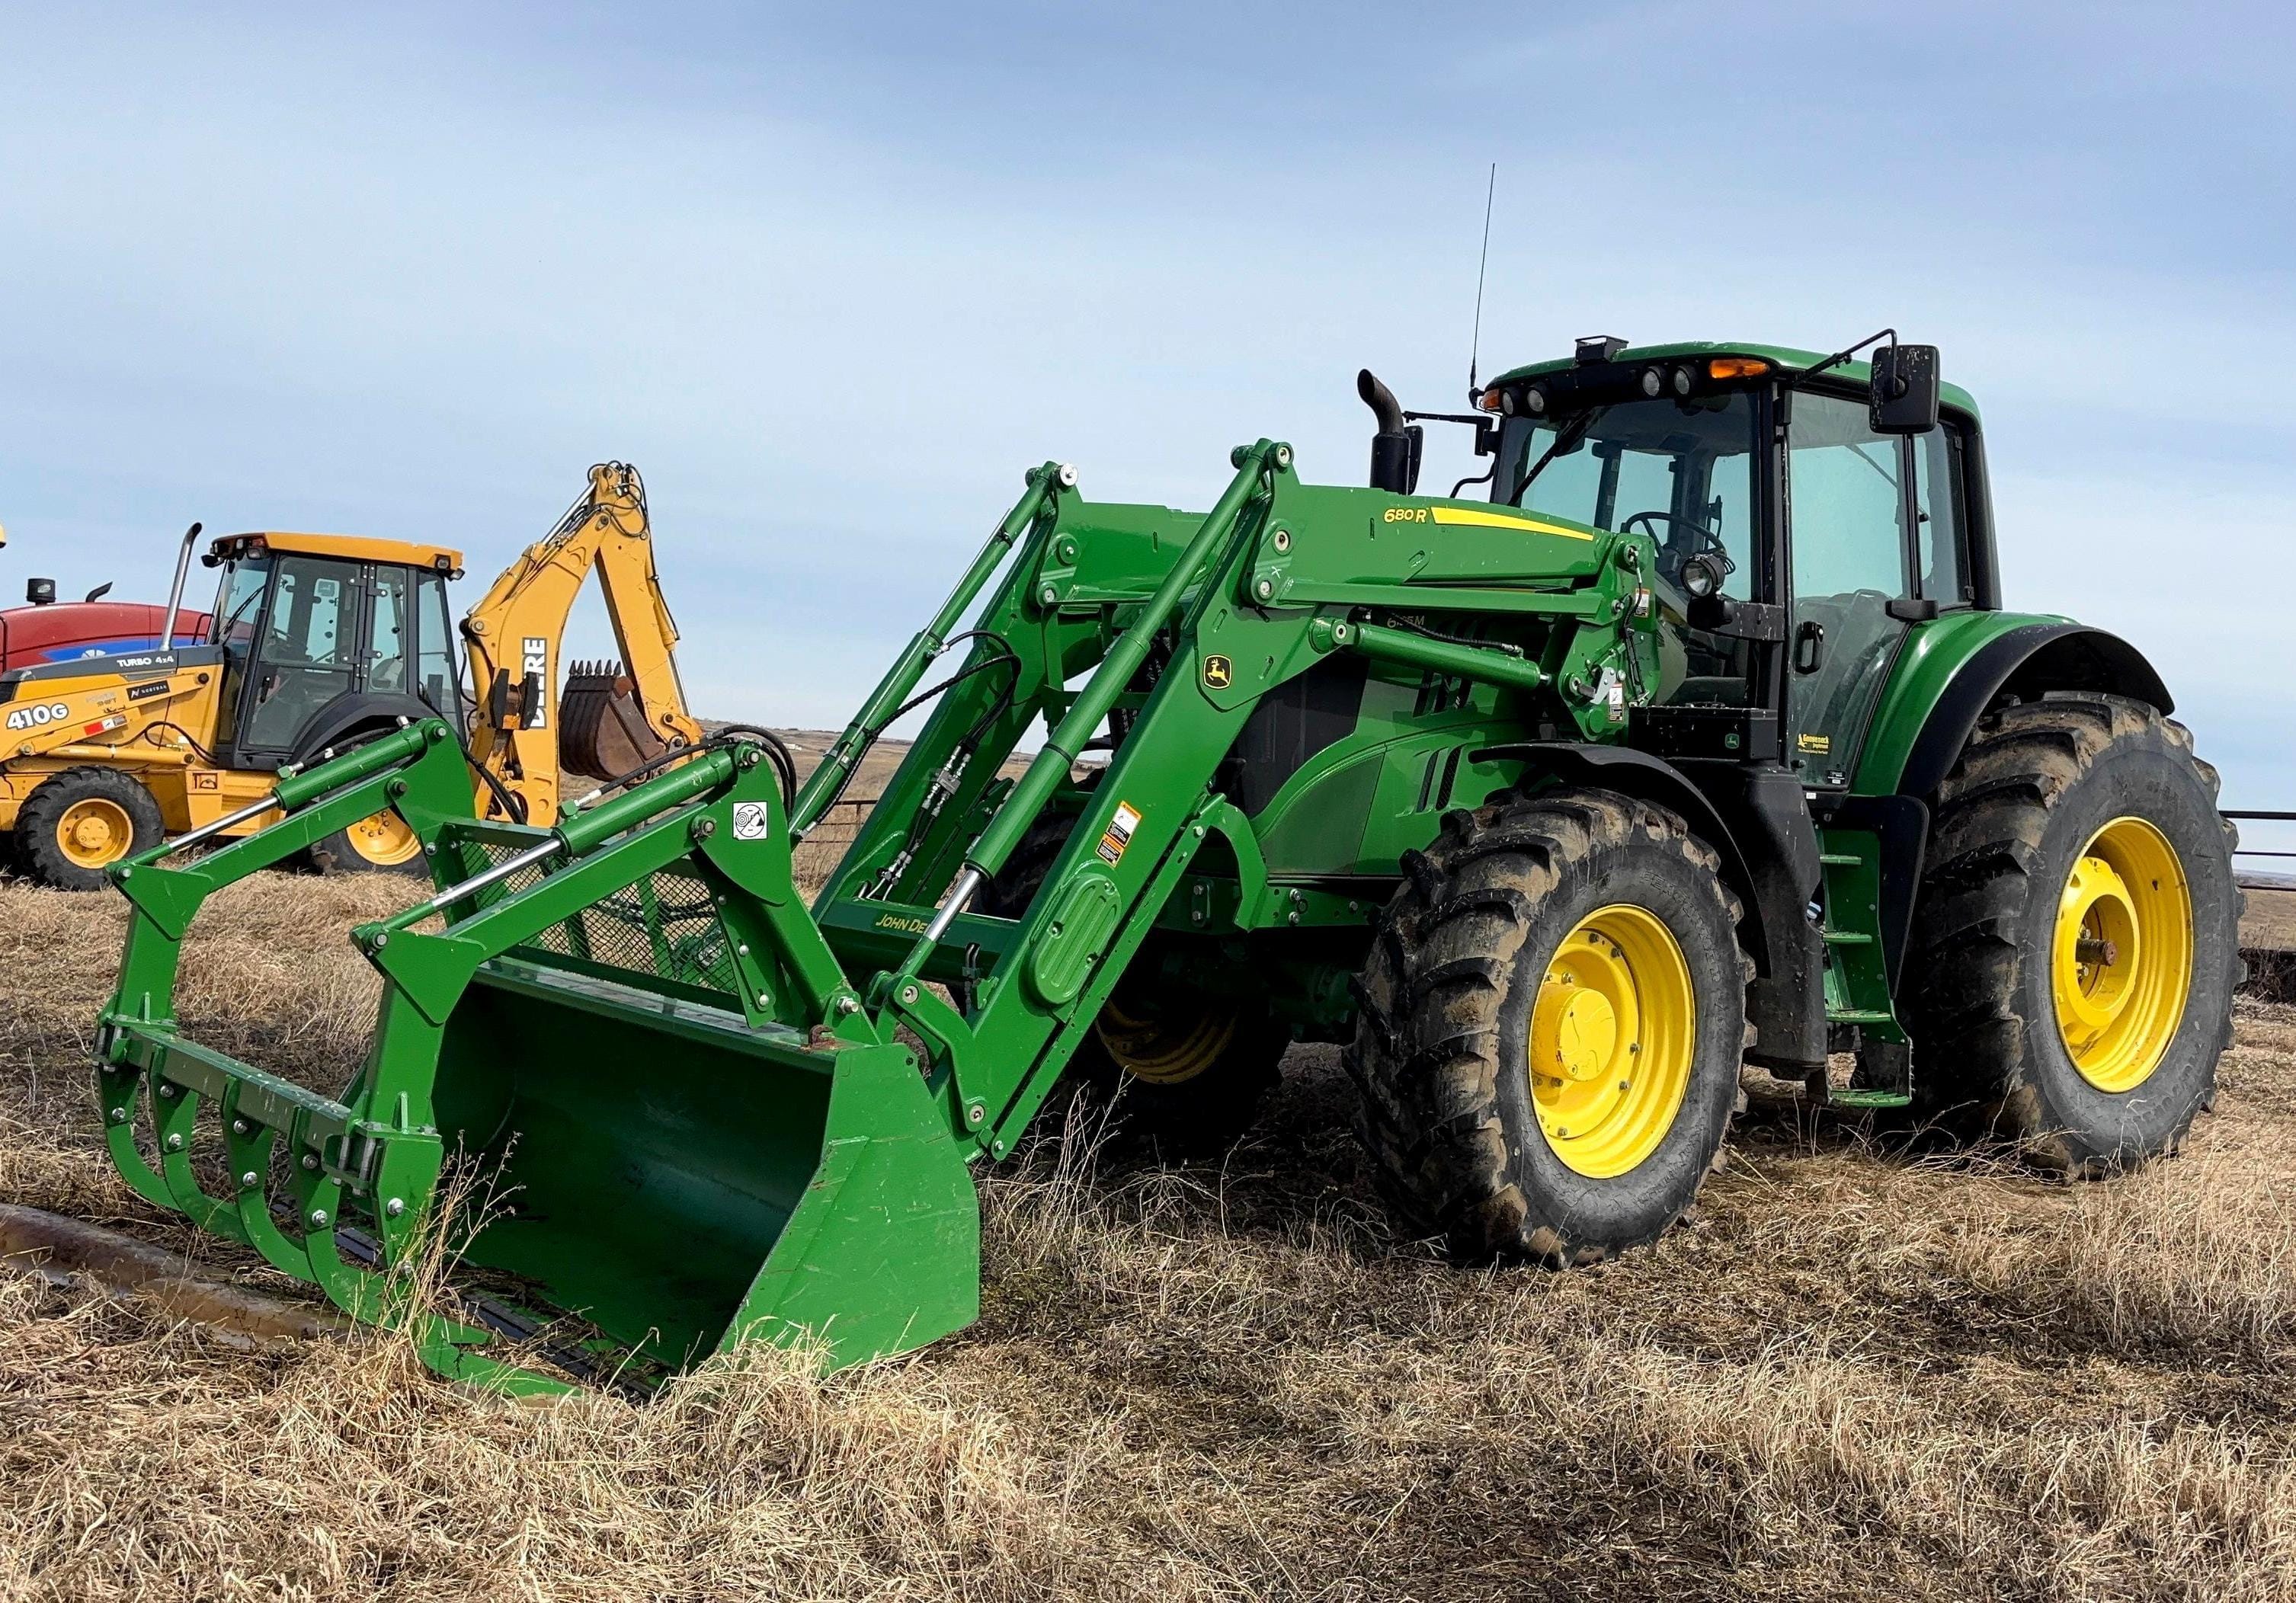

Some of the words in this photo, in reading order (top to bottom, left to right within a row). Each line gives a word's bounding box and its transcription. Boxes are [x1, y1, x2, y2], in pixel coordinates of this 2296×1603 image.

[117, 657, 152, 667] TURBO
[155, 655, 175, 664] 4x4
[7, 702, 69, 731] 410G
[876, 913, 909, 931] JOHN
